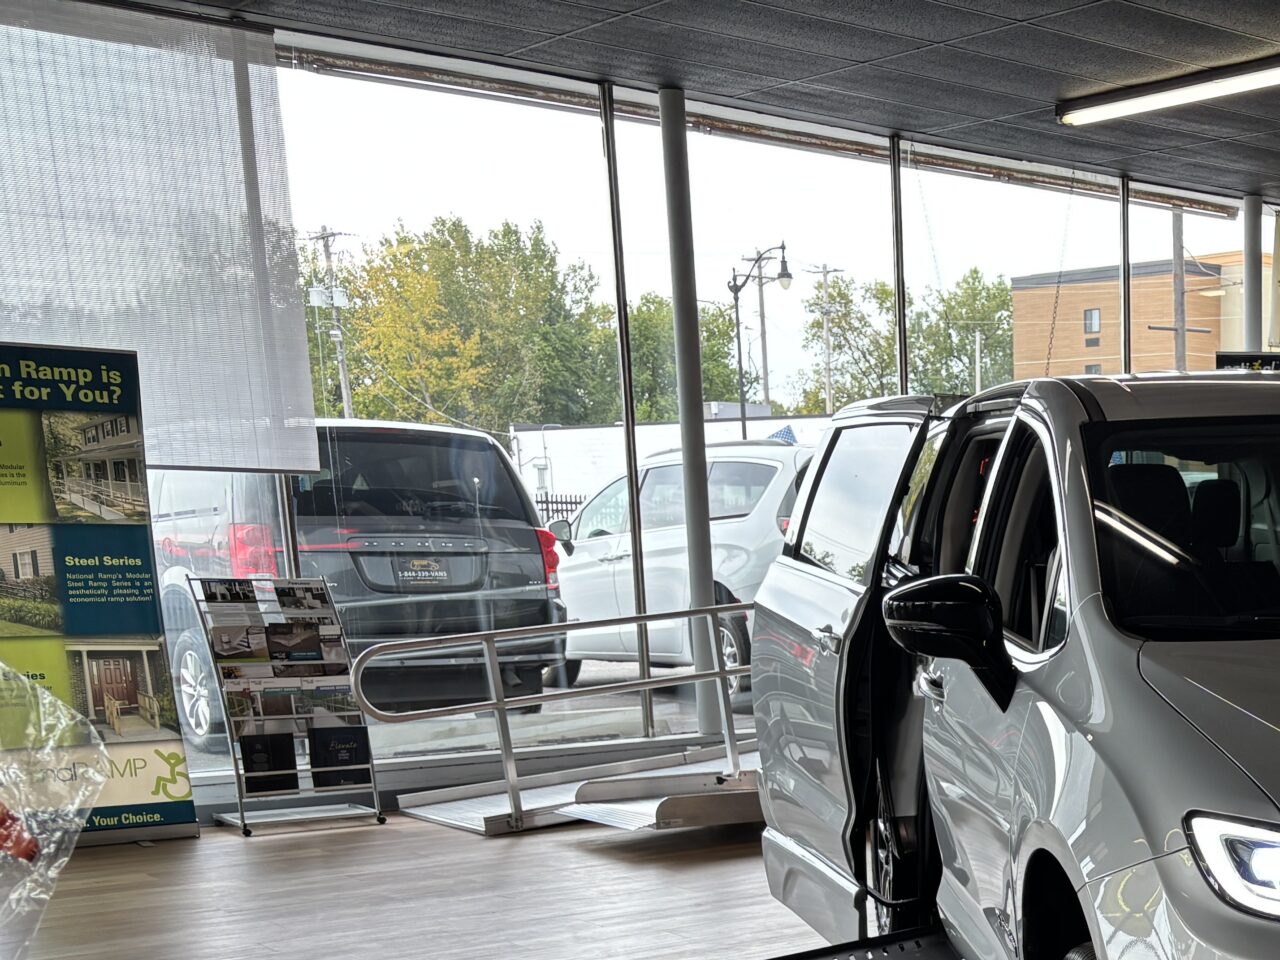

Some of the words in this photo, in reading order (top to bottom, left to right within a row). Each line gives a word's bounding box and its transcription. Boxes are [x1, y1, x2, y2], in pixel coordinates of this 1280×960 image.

[19, 360, 93, 386] Ramp
[100, 365, 122, 384] is
[12, 381, 51, 400] for
[58, 383, 121, 404] You?
[65, 556, 99, 566] Steel
[103, 556, 142, 566] Series
[92, 815, 119, 827] Your
[121, 813, 164, 824] Choice.
